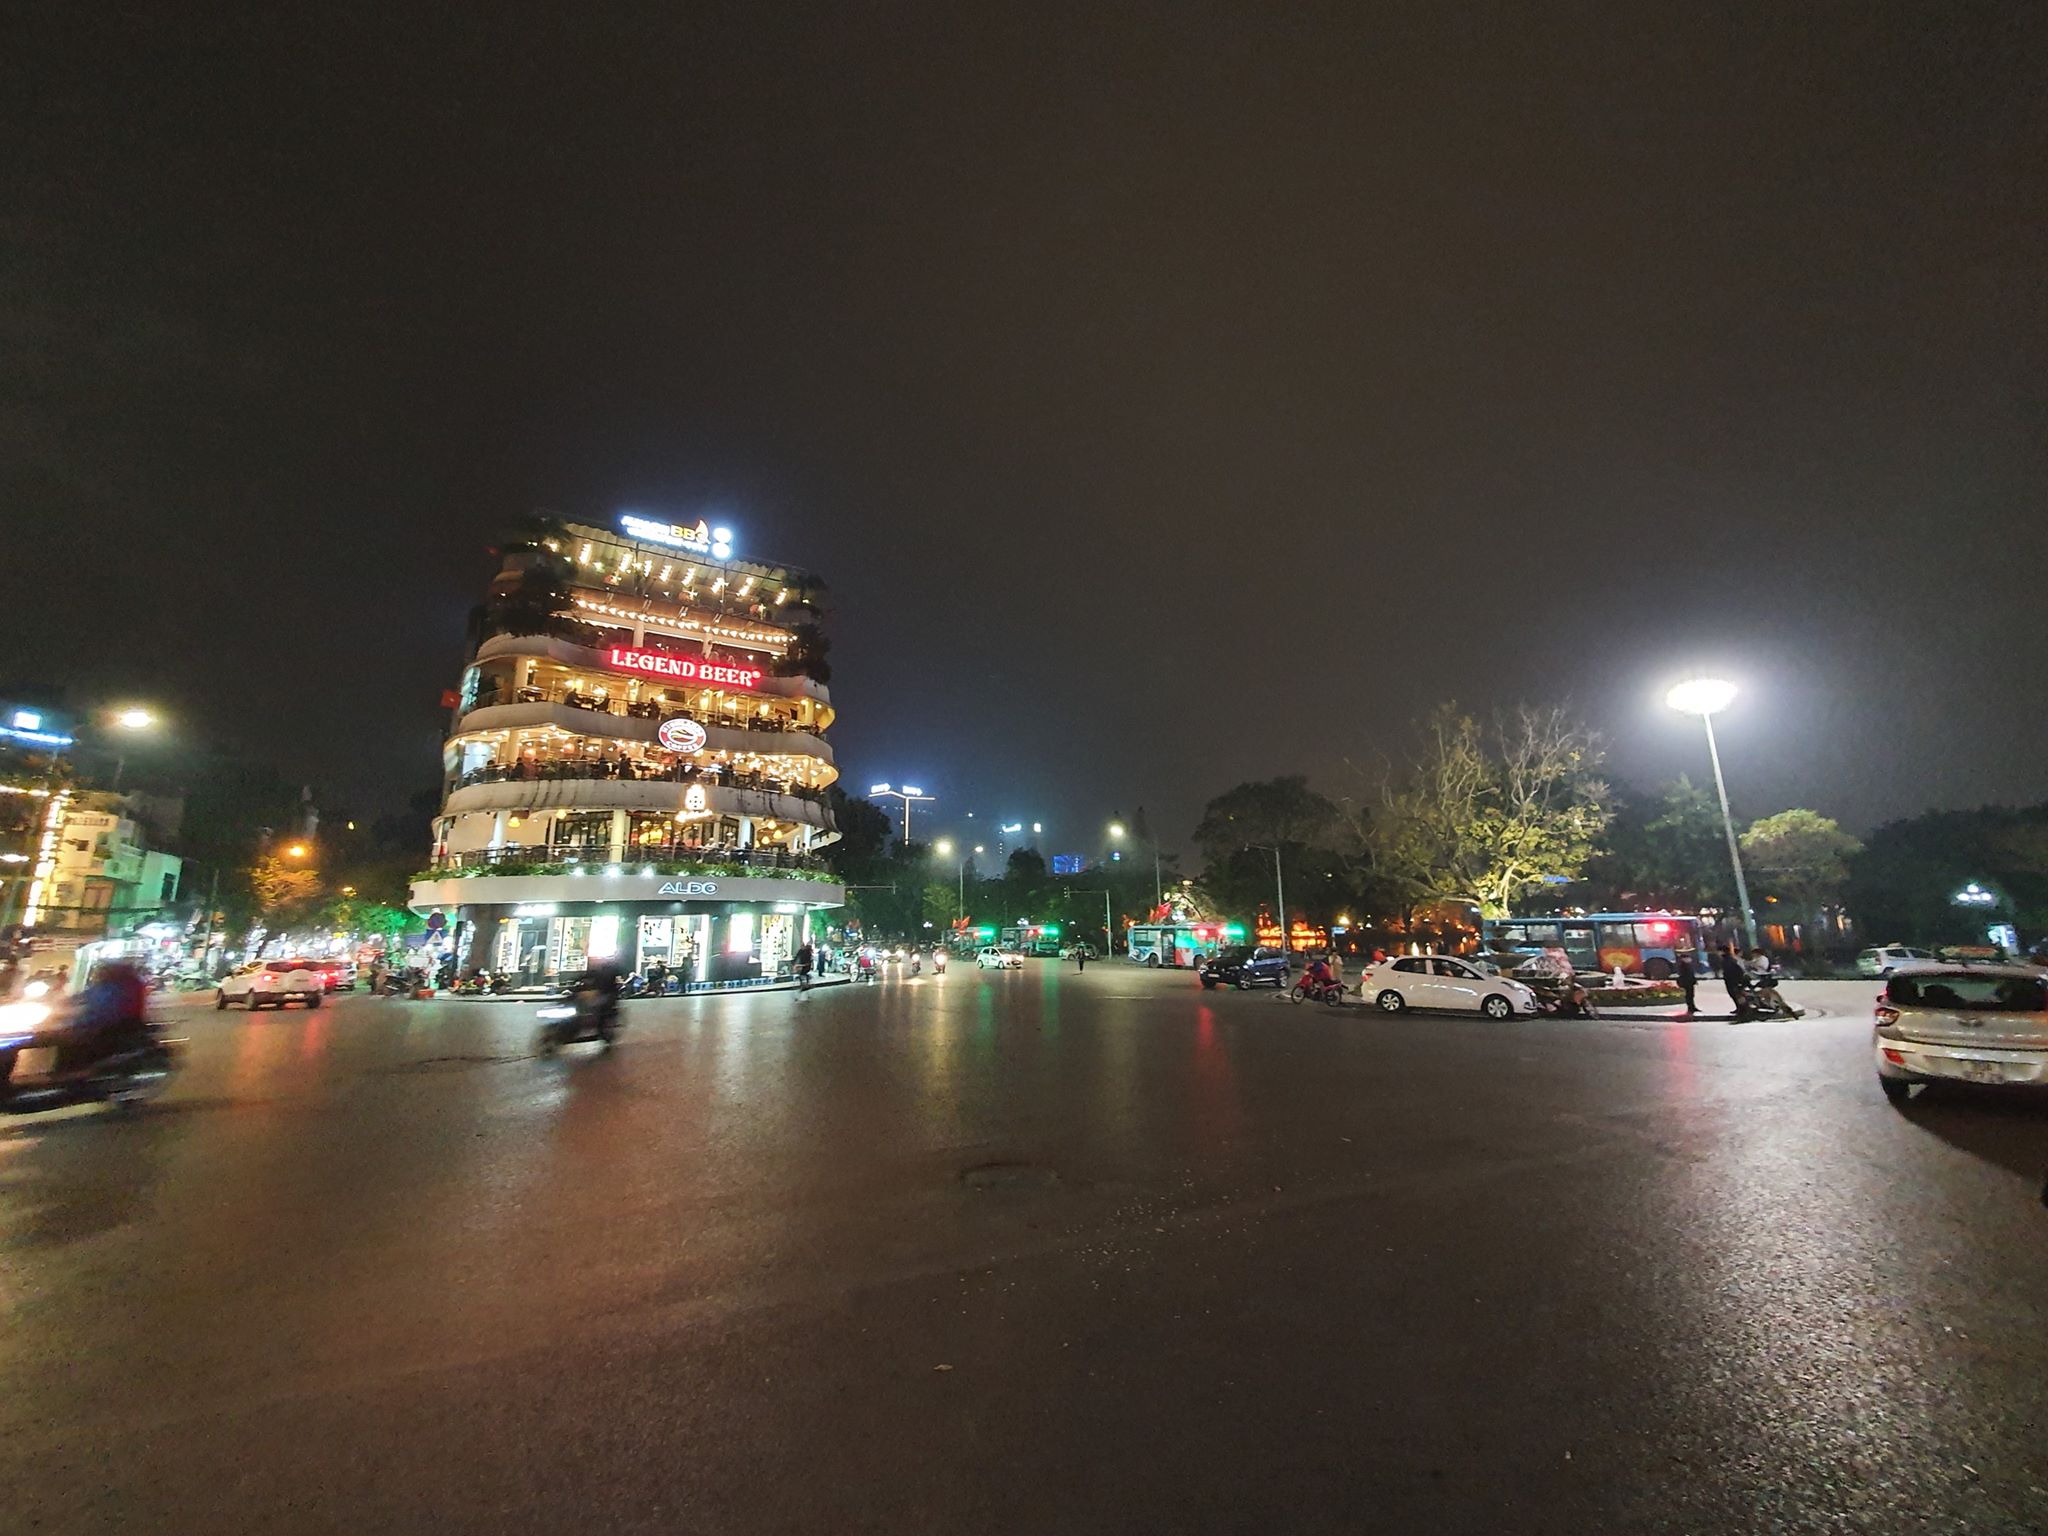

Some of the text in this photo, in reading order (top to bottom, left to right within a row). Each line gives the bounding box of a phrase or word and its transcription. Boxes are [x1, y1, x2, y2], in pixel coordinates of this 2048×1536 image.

[611, 649, 753, 687] LEGEND BEER
[658, 882, 718, 895] ALDO
